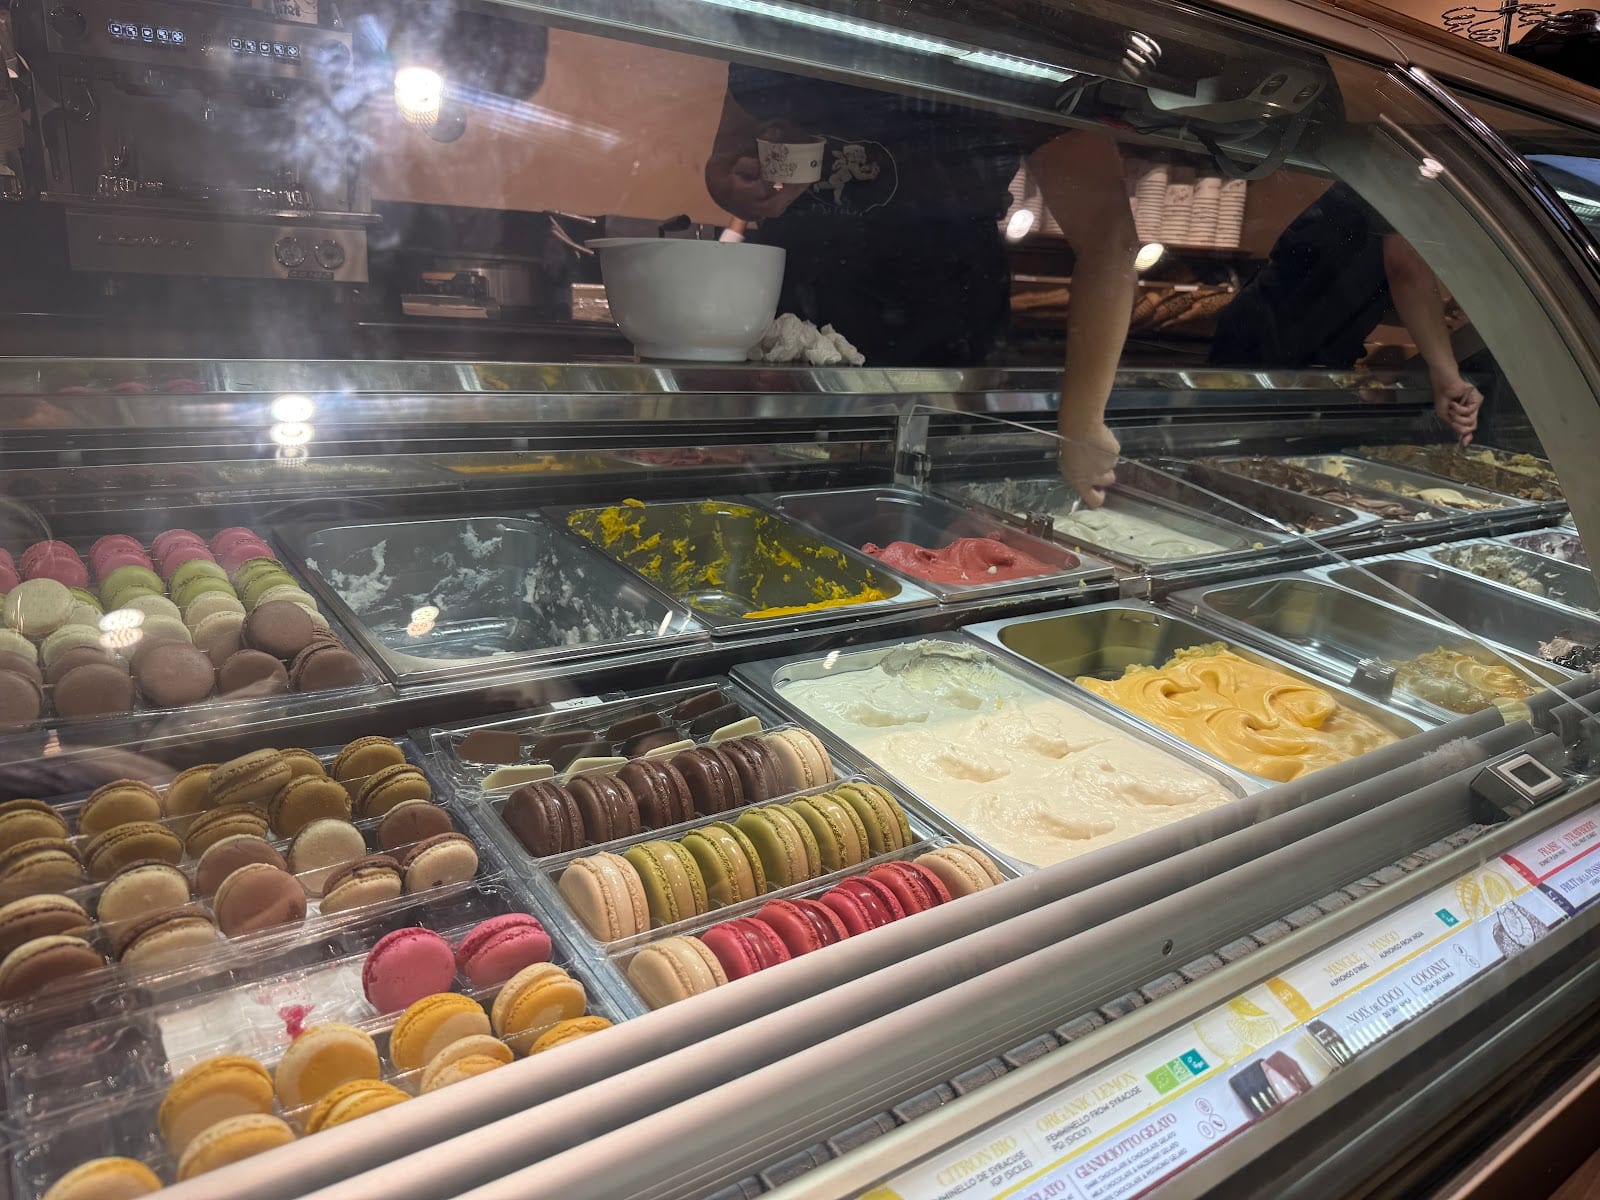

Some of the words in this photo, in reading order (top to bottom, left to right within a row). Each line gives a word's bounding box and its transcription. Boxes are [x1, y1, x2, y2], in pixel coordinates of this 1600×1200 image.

[1410, 958, 1451, 986] COCONUT
[1376, 985, 1404, 1008] COCO
[1036, 1091, 1095, 1132] ORGANIC
[1092, 1071, 1138, 1103] LEMON
[1089, 1104, 1110, 1119] FROM
[1108, 1086, 1142, 1108] SYRACUSE
[1138, 1112, 1178, 1141] GELATO
[936, 1146, 993, 1187] CITRON
[990, 1135, 1018, 1158] BIO
[975, 1171, 989, 1182] DE
[988, 1150, 1026, 1175] SYRACUSE
